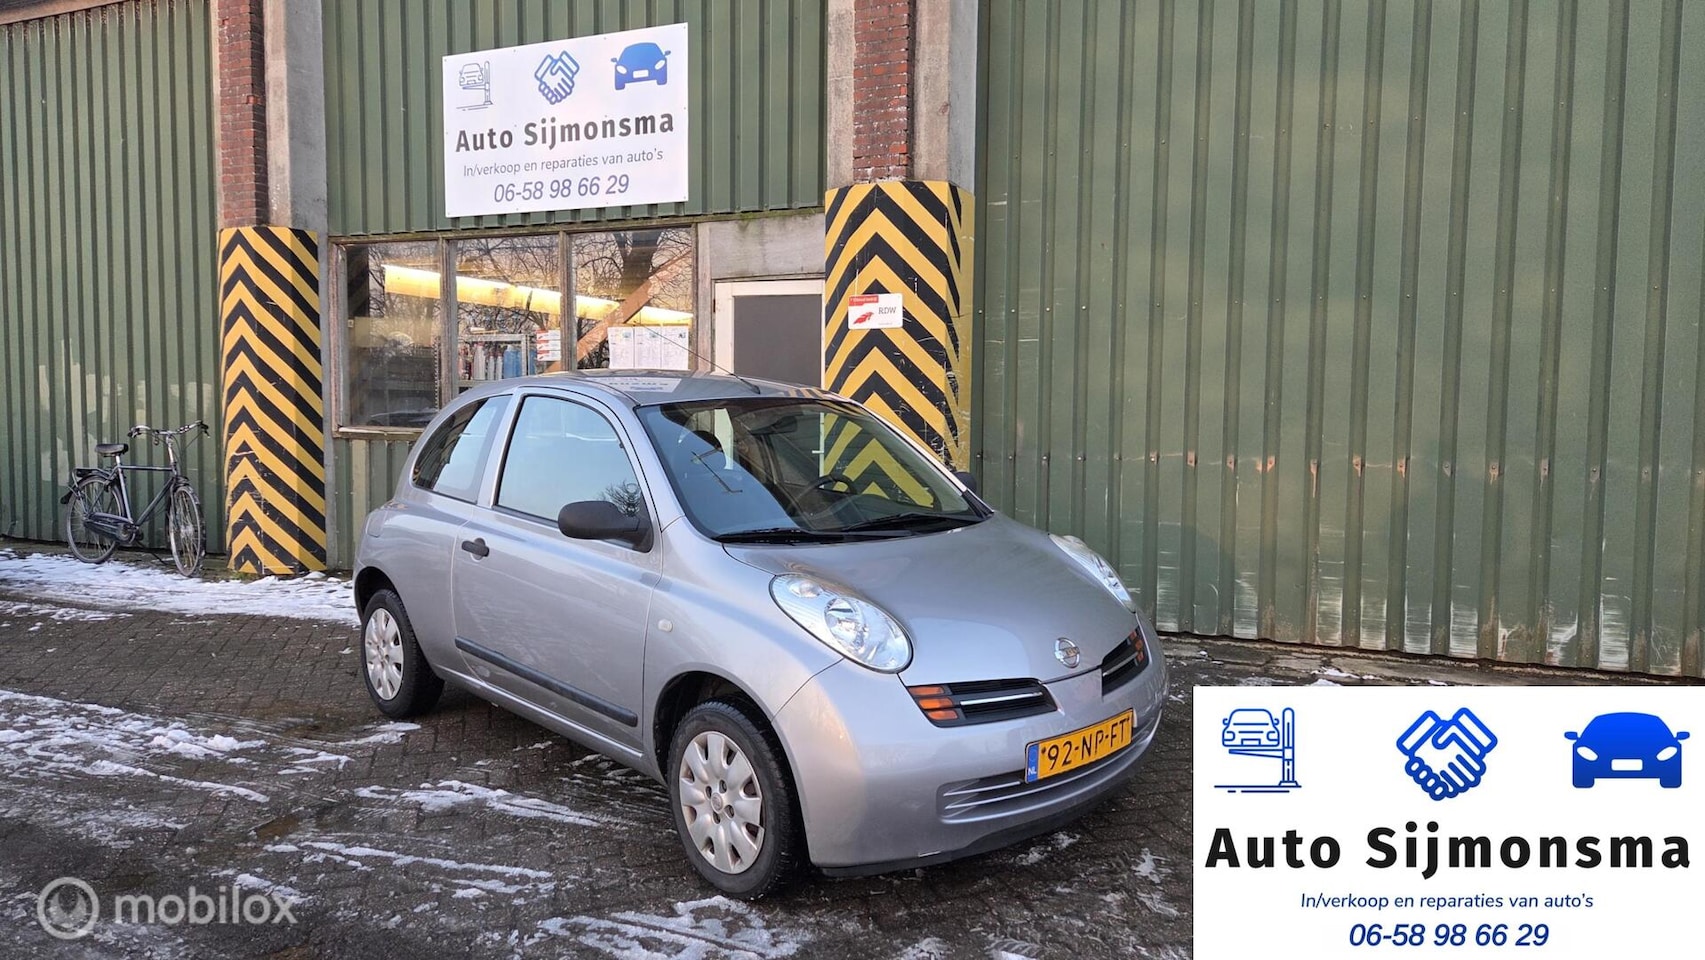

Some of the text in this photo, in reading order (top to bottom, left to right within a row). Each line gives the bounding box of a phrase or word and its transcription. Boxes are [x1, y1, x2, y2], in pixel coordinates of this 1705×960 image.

[456, 112, 674, 152] Auto Sijmonsma
[463, 148, 664, 177] In/verkoop en reparaties van auto's
[494, 174, 630, 203] 06-58 98 66 29
[878, 306, 897, 315] RDW
[1047, 719, 1127, 770] 92-NP-FT
[1028, 767, 1037, 776] NL
